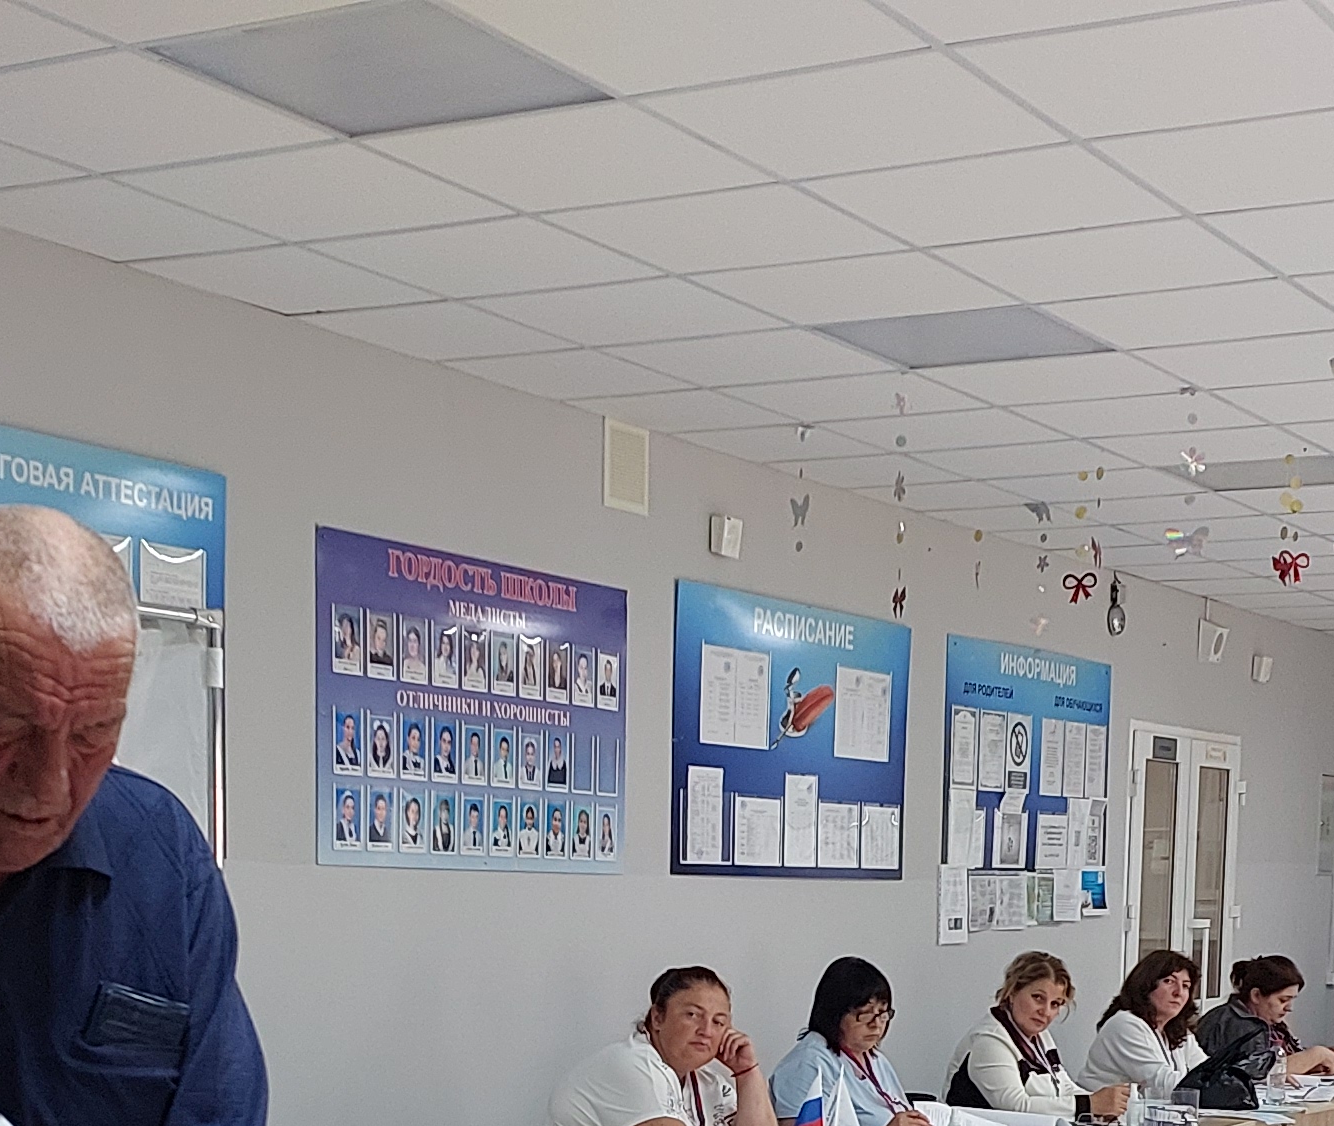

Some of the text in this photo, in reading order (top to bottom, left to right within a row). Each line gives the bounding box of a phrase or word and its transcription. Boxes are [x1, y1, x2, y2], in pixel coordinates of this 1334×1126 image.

[80, 464, 213, 521] АТТЕСТАЦИЯ
[387, 548, 577, 613] ГОРДОСТЬ ШКОЛЫ
[448, 599, 526, 630] МЕДАЛИСТЫ
[753, 607, 854, 651] РАСПИСАНИЕ
[999, 652, 1077, 688] ИНФОРМАЦИЯ
[396, 689, 571, 727] ОТЛИЧНИКИ И ХОРОШИСТЫ
[978, 684, 1014, 700] РОДИТЕЛЕЙ
